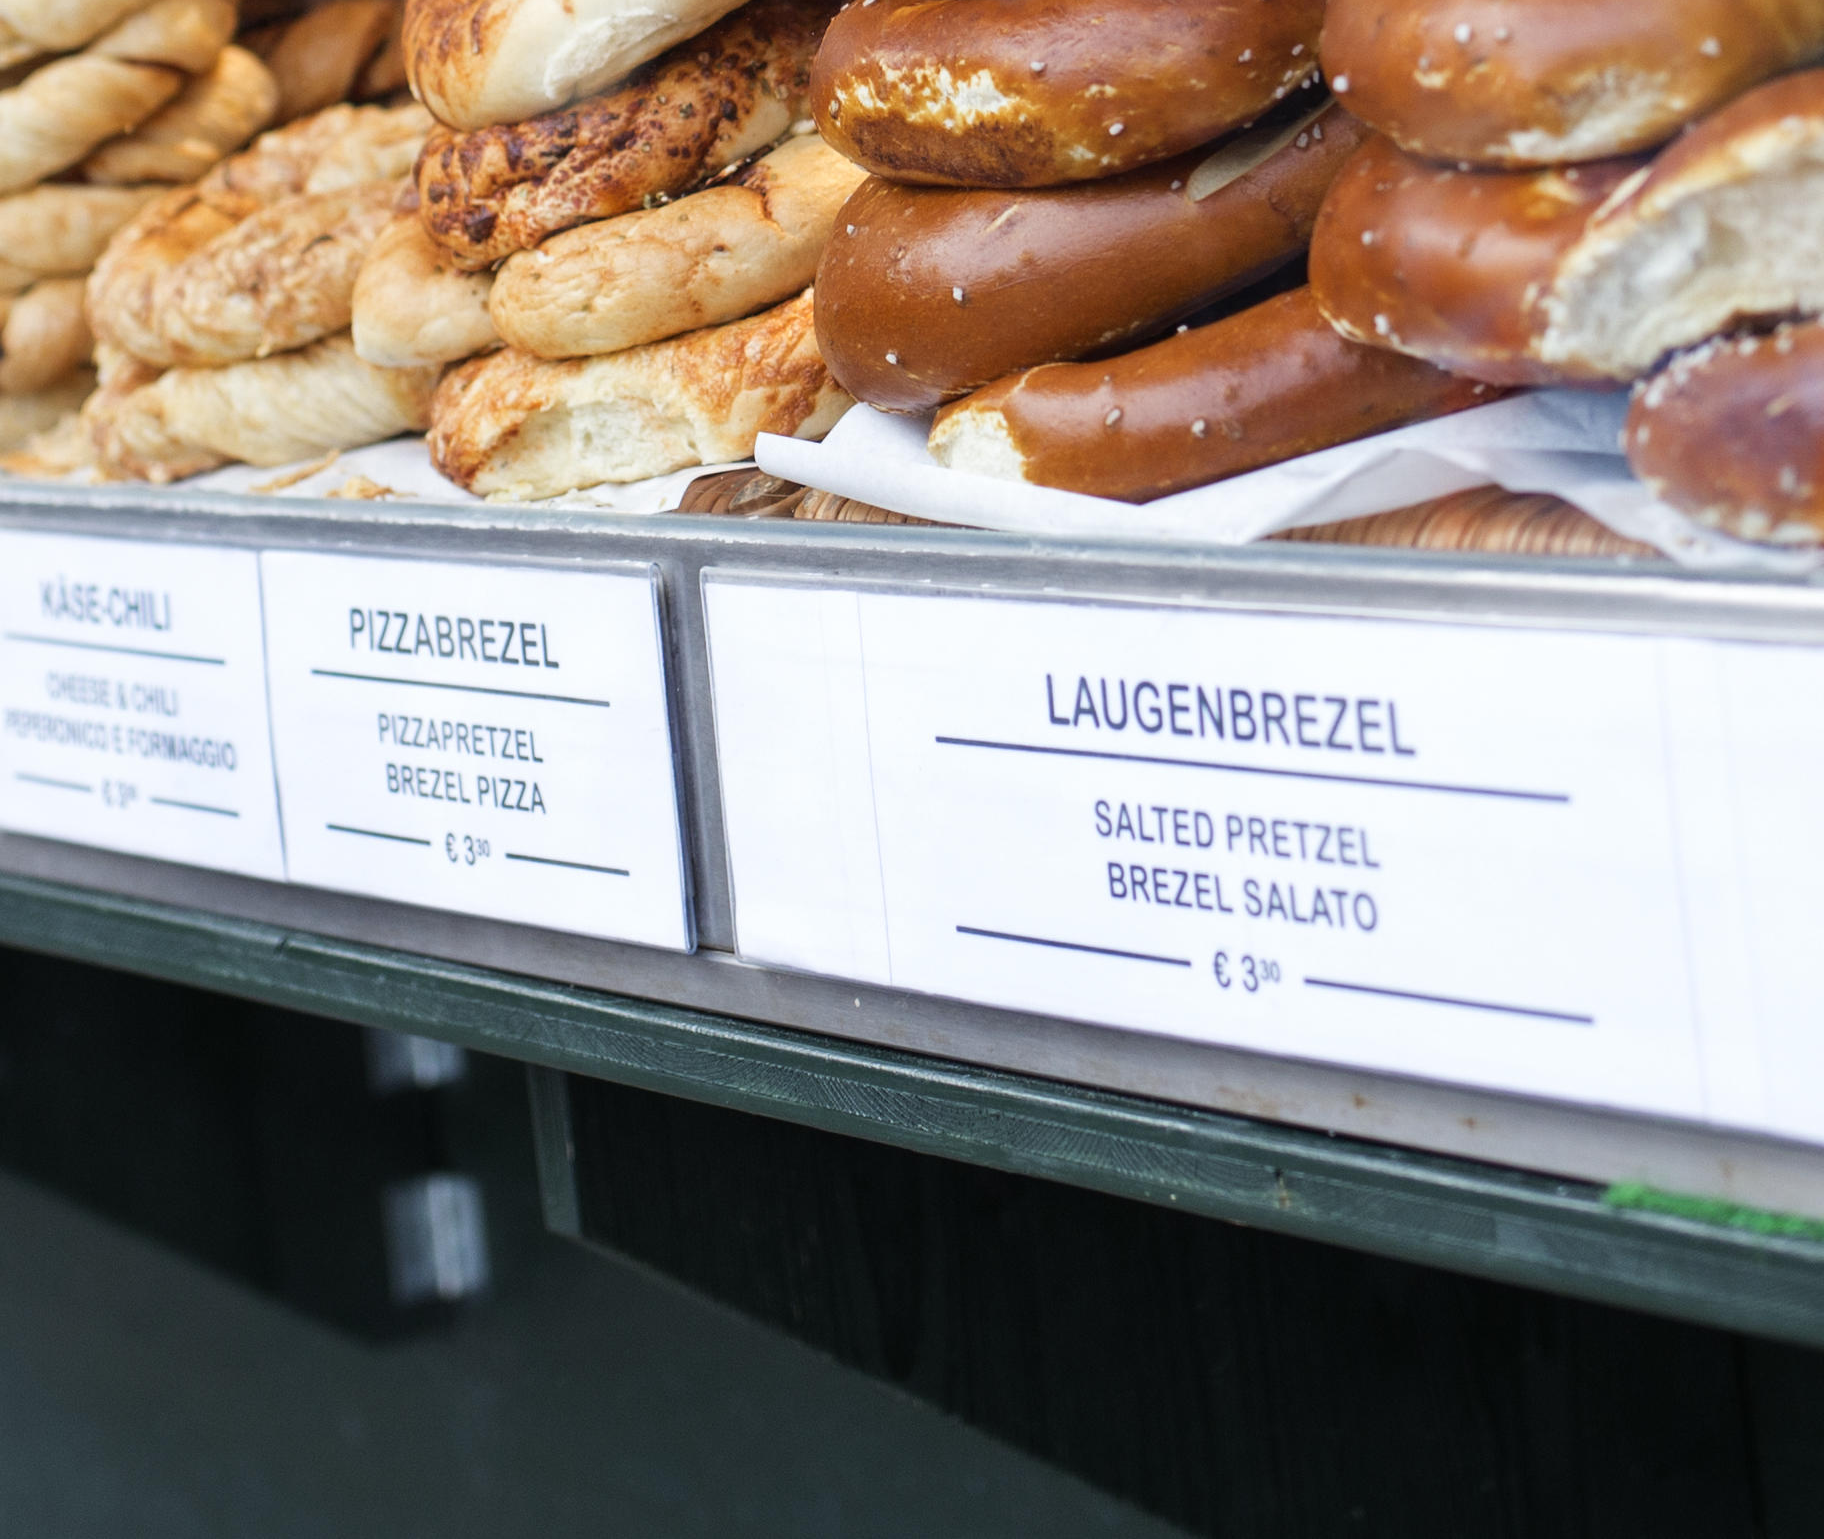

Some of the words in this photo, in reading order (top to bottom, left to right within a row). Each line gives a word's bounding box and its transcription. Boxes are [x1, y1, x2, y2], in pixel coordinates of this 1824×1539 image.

[39, 574, 171, 631] KÄSE-CHILI
[348, 608, 560, 669] PIZZABREZEL
[133, 683, 179, 718] CHILI
[1045, 674, 1416, 755] LAUGENBREZEL
[112, 723, 124, 754] E
[127, 727, 238, 772] FORMAGGIO
[378, 713, 544, 764] PIZZAPRETZEL
[387, 763, 472, 805] BREZEL
[477, 775, 547, 814] PIZZA
[446, 833, 459, 864] €
[1095, 800, 1215, 849] SALTED
[1226, 814, 1381, 868] PRETZEL
[1107, 862, 1234, 914] BREZEL
[1244, 879, 1379, 932] SALATO
[1213, 951, 1232, 990] €
